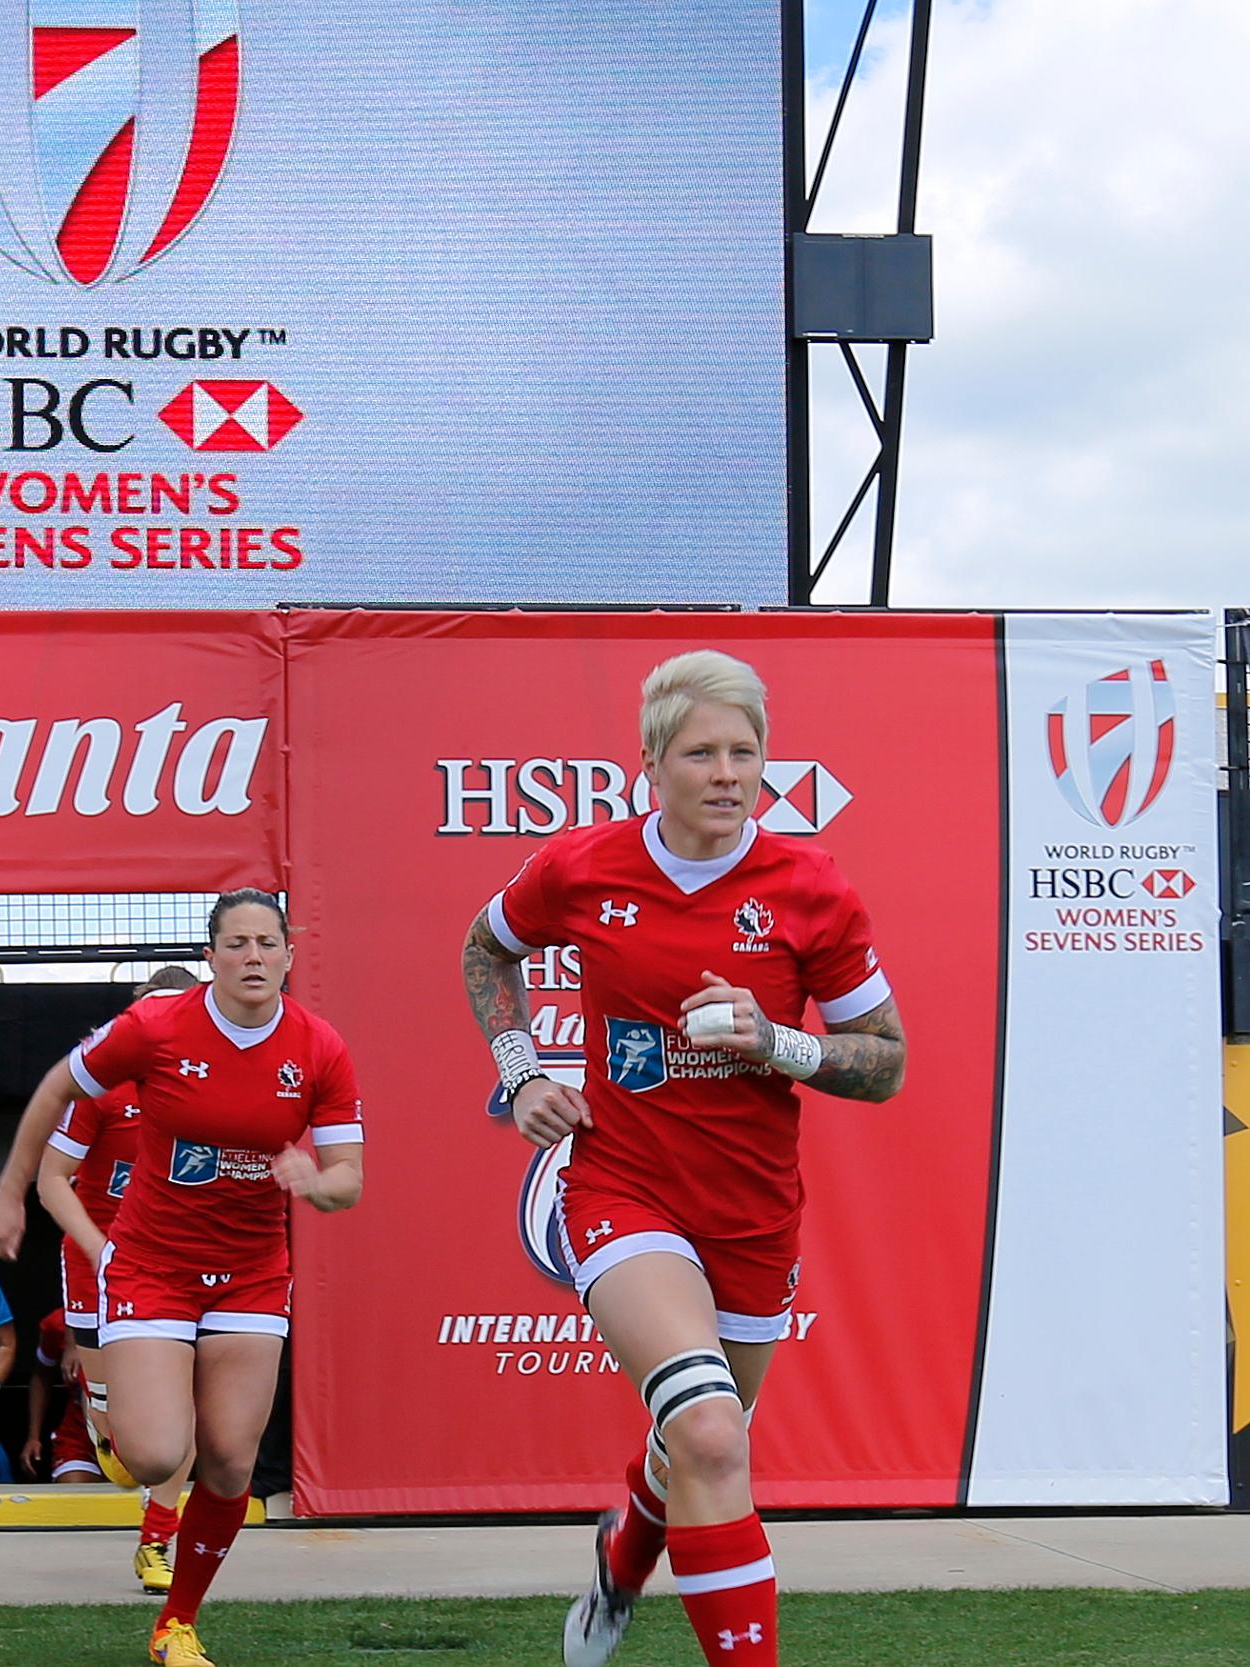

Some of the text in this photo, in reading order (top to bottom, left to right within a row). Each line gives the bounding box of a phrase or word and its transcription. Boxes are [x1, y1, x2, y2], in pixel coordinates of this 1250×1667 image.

[110, 528, 302, 569] SERIES
[437, 758, 658, 834] HSB
[1044, 845, 1114, 859] WORLD
[1029, 868, 1135, 899] HSBC
[1056, 908, 1177, 927] WOMEN'S
[1025, 932, 1203, 952] SEVENS SERIES
[669, 1061, 772, 1079] CHAMPIONS
[220, 1160, 266, 1172] WOMEN
